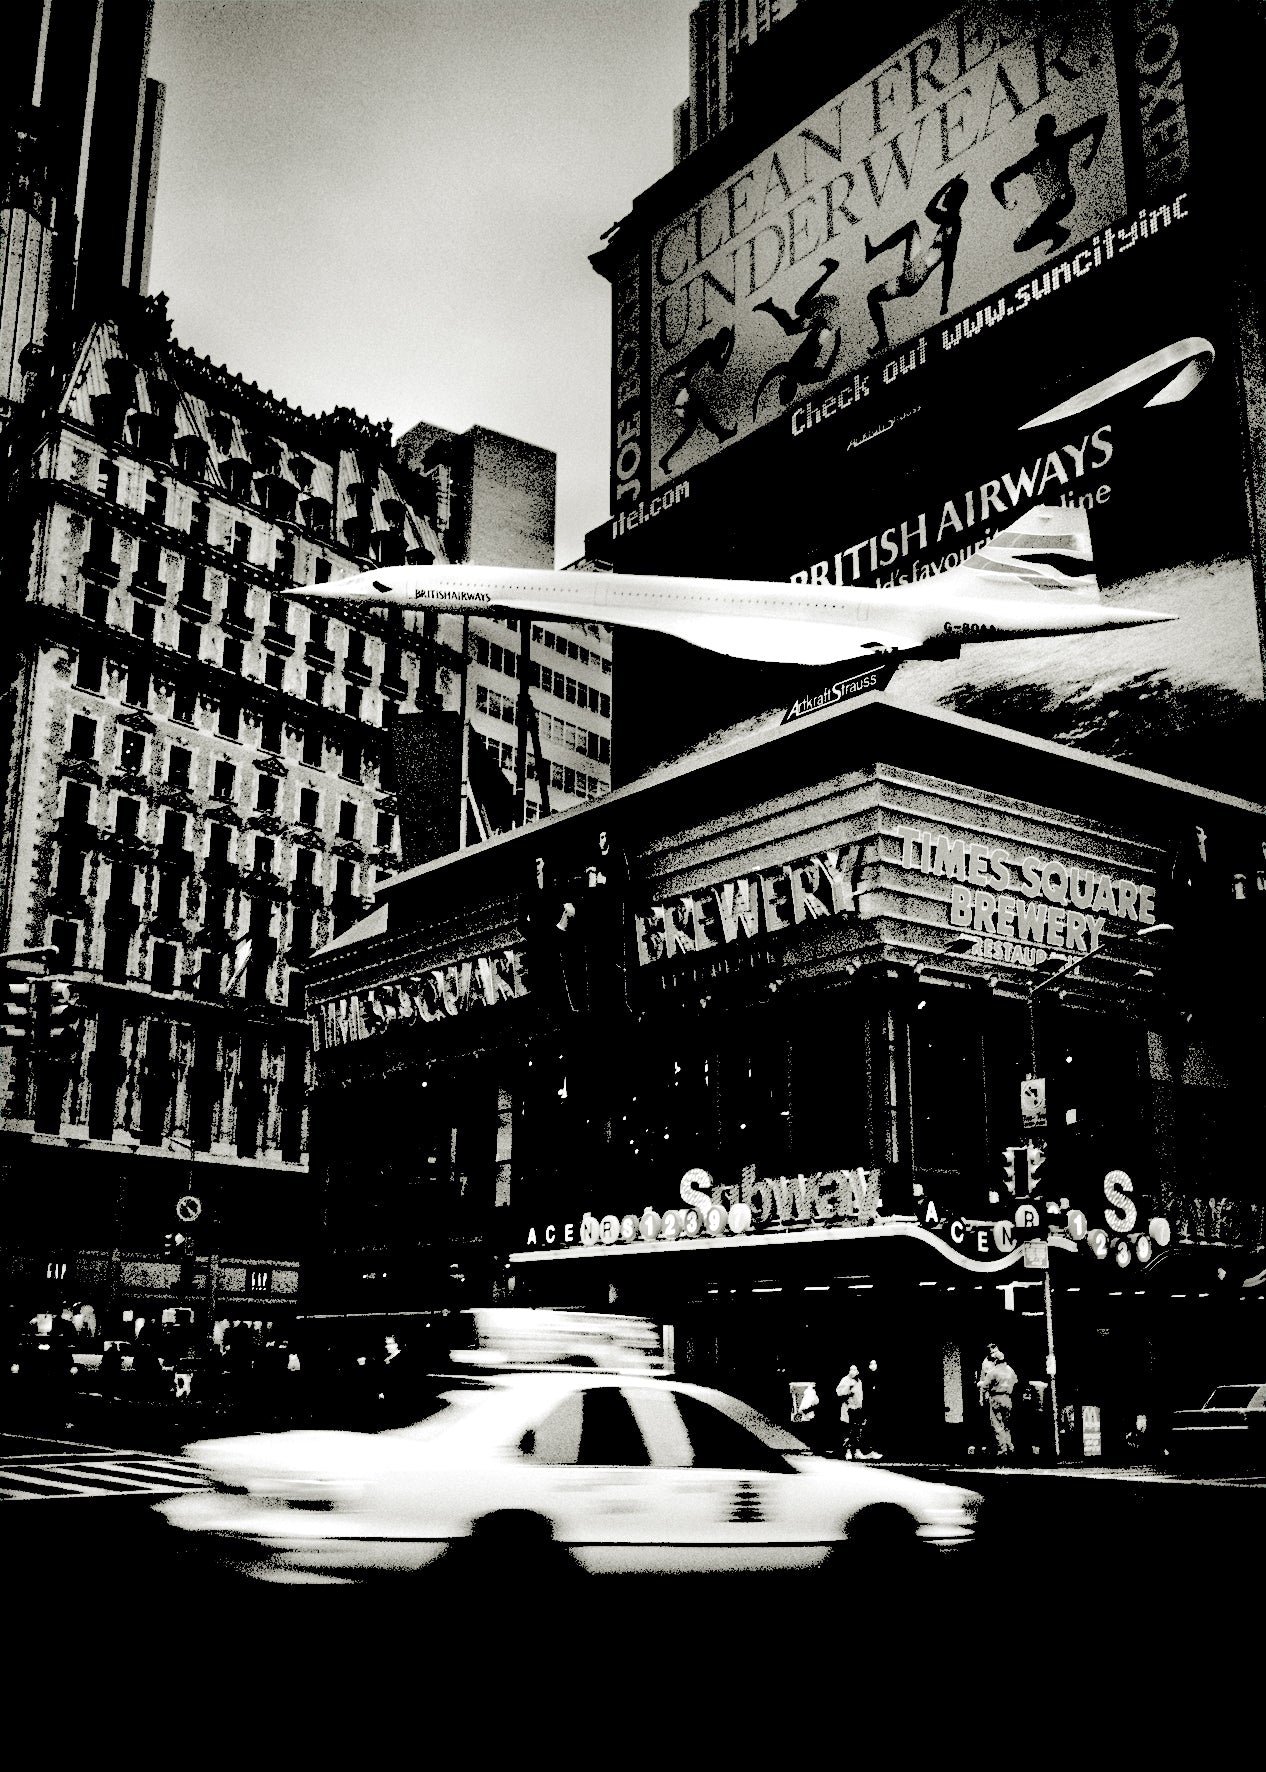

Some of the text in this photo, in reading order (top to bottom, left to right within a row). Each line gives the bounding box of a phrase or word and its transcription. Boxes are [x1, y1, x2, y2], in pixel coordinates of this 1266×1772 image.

[655, 100, 845, 287] CLEAN
[792, 374, 869, 436] Check
[883, 337, 927, 384] out
[942, 193, 1188, 350] www.suncityinc
[616, 410, 641, 500] JOE
[936, 424, 1114, 542] AIRWAYS
[613, 481, 690, 540] tel.com
[634, 844, 859, 966] BREWERY
[897, 825, 1156, 925] TIMES SQUARE
[950, 884, 1106, 952] BREWERY
